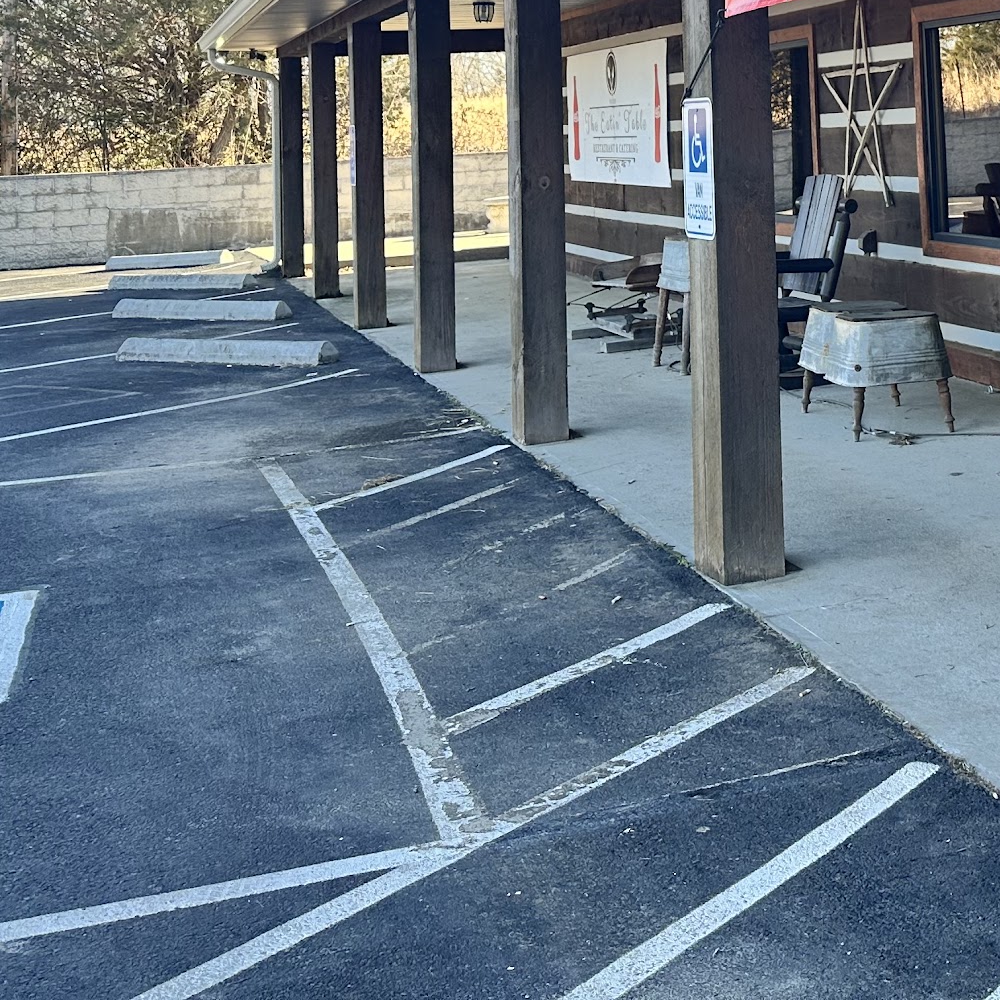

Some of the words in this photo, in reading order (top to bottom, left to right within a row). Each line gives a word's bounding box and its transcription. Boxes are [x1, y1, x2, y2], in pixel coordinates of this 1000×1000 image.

[584, 112, 598, 135] The
[623, 109, 647, 134] Table
[687, 203, 713, 222] ACCESSIBLE
